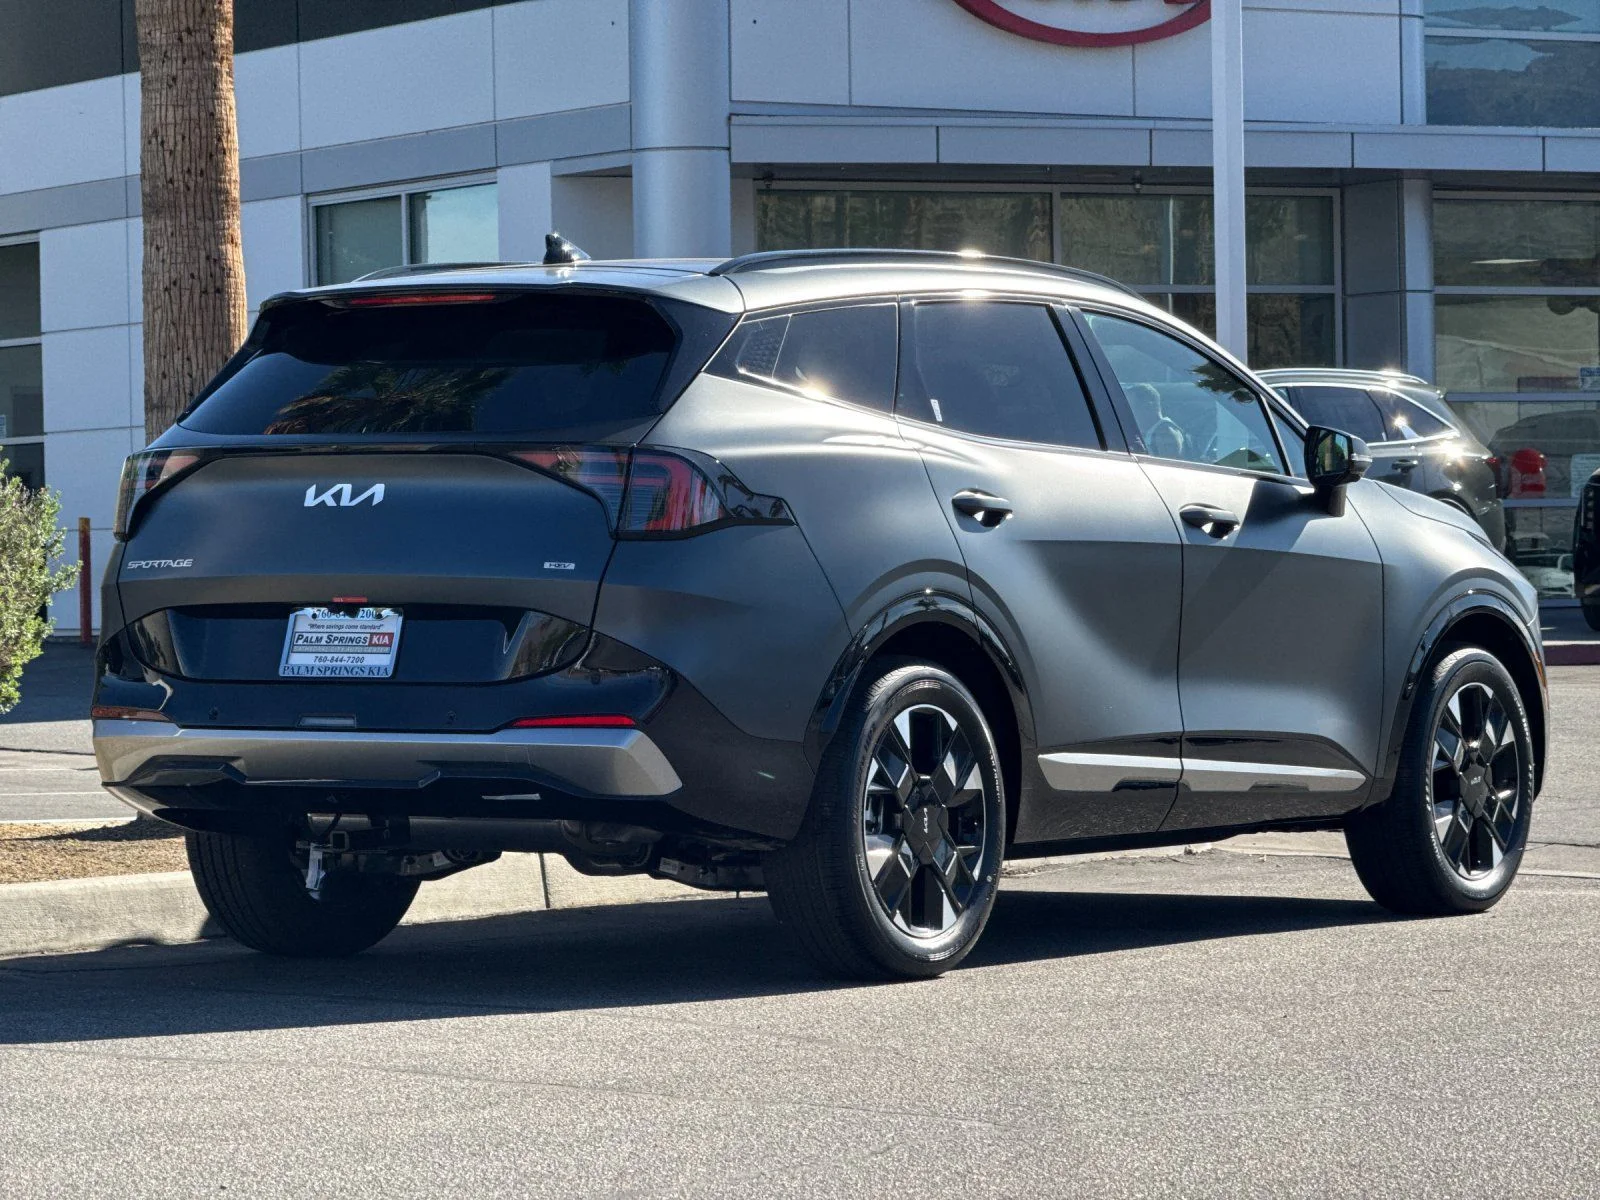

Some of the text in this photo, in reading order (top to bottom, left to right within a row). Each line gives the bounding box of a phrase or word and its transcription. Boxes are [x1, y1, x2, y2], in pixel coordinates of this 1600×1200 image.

[304, 483, 385, 507] KIA
[127, 558, 194, 569] SPORTAGE
[295, 634, 390, 645] PALM SPRINGS KIA
[313, 655, 365, 664] 760-844-7200
[282, 665, 389, 677] PALM SPRINGS KIA
